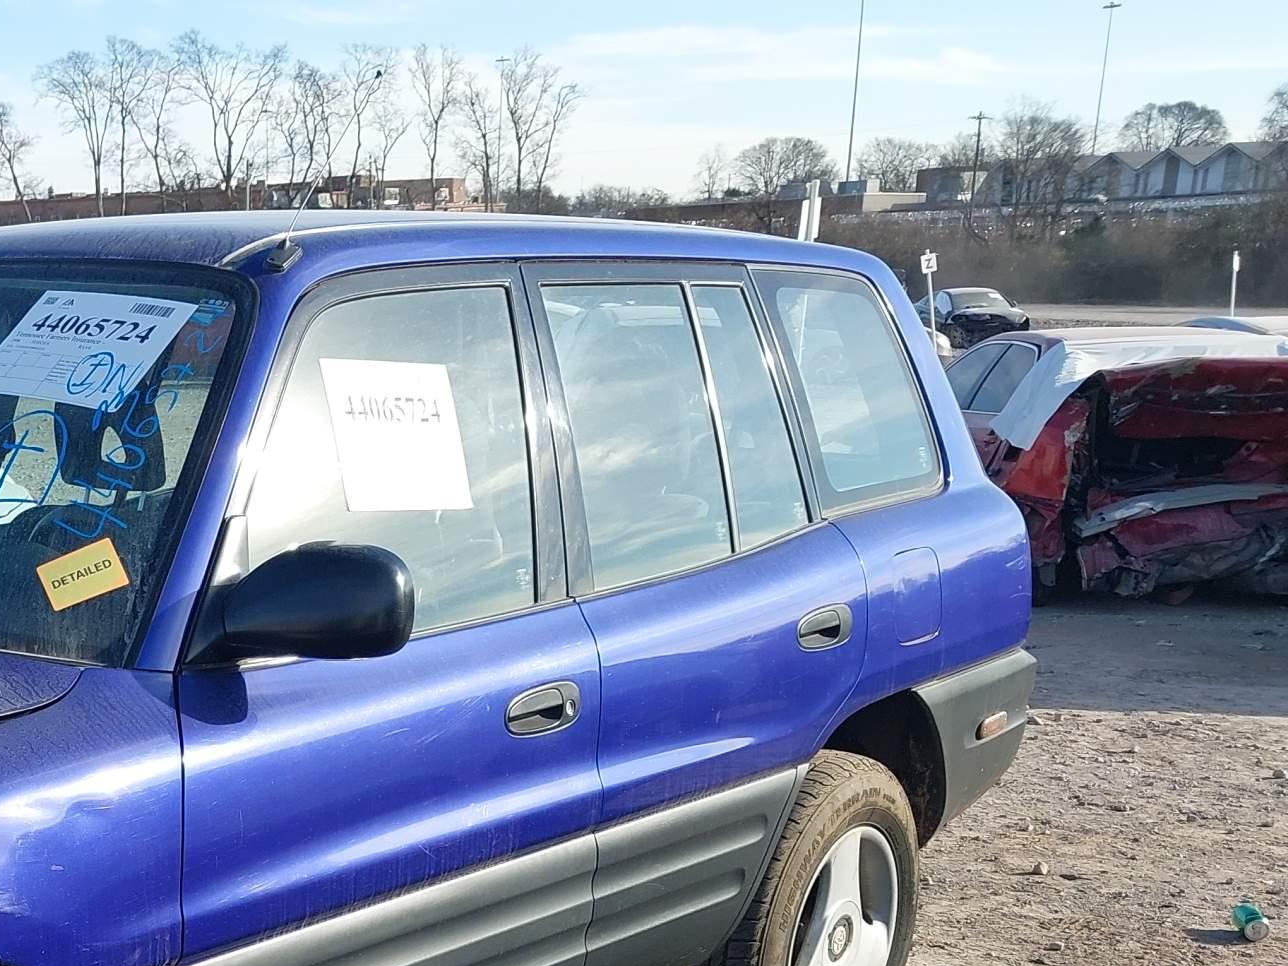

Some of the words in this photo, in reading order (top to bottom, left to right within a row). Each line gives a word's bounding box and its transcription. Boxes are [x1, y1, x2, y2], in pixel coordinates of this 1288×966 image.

[32, 313, 157, 344] 44065724
[345, 395, 441, 423] 44065724
[51, 558, 113, 590] DETAILED
